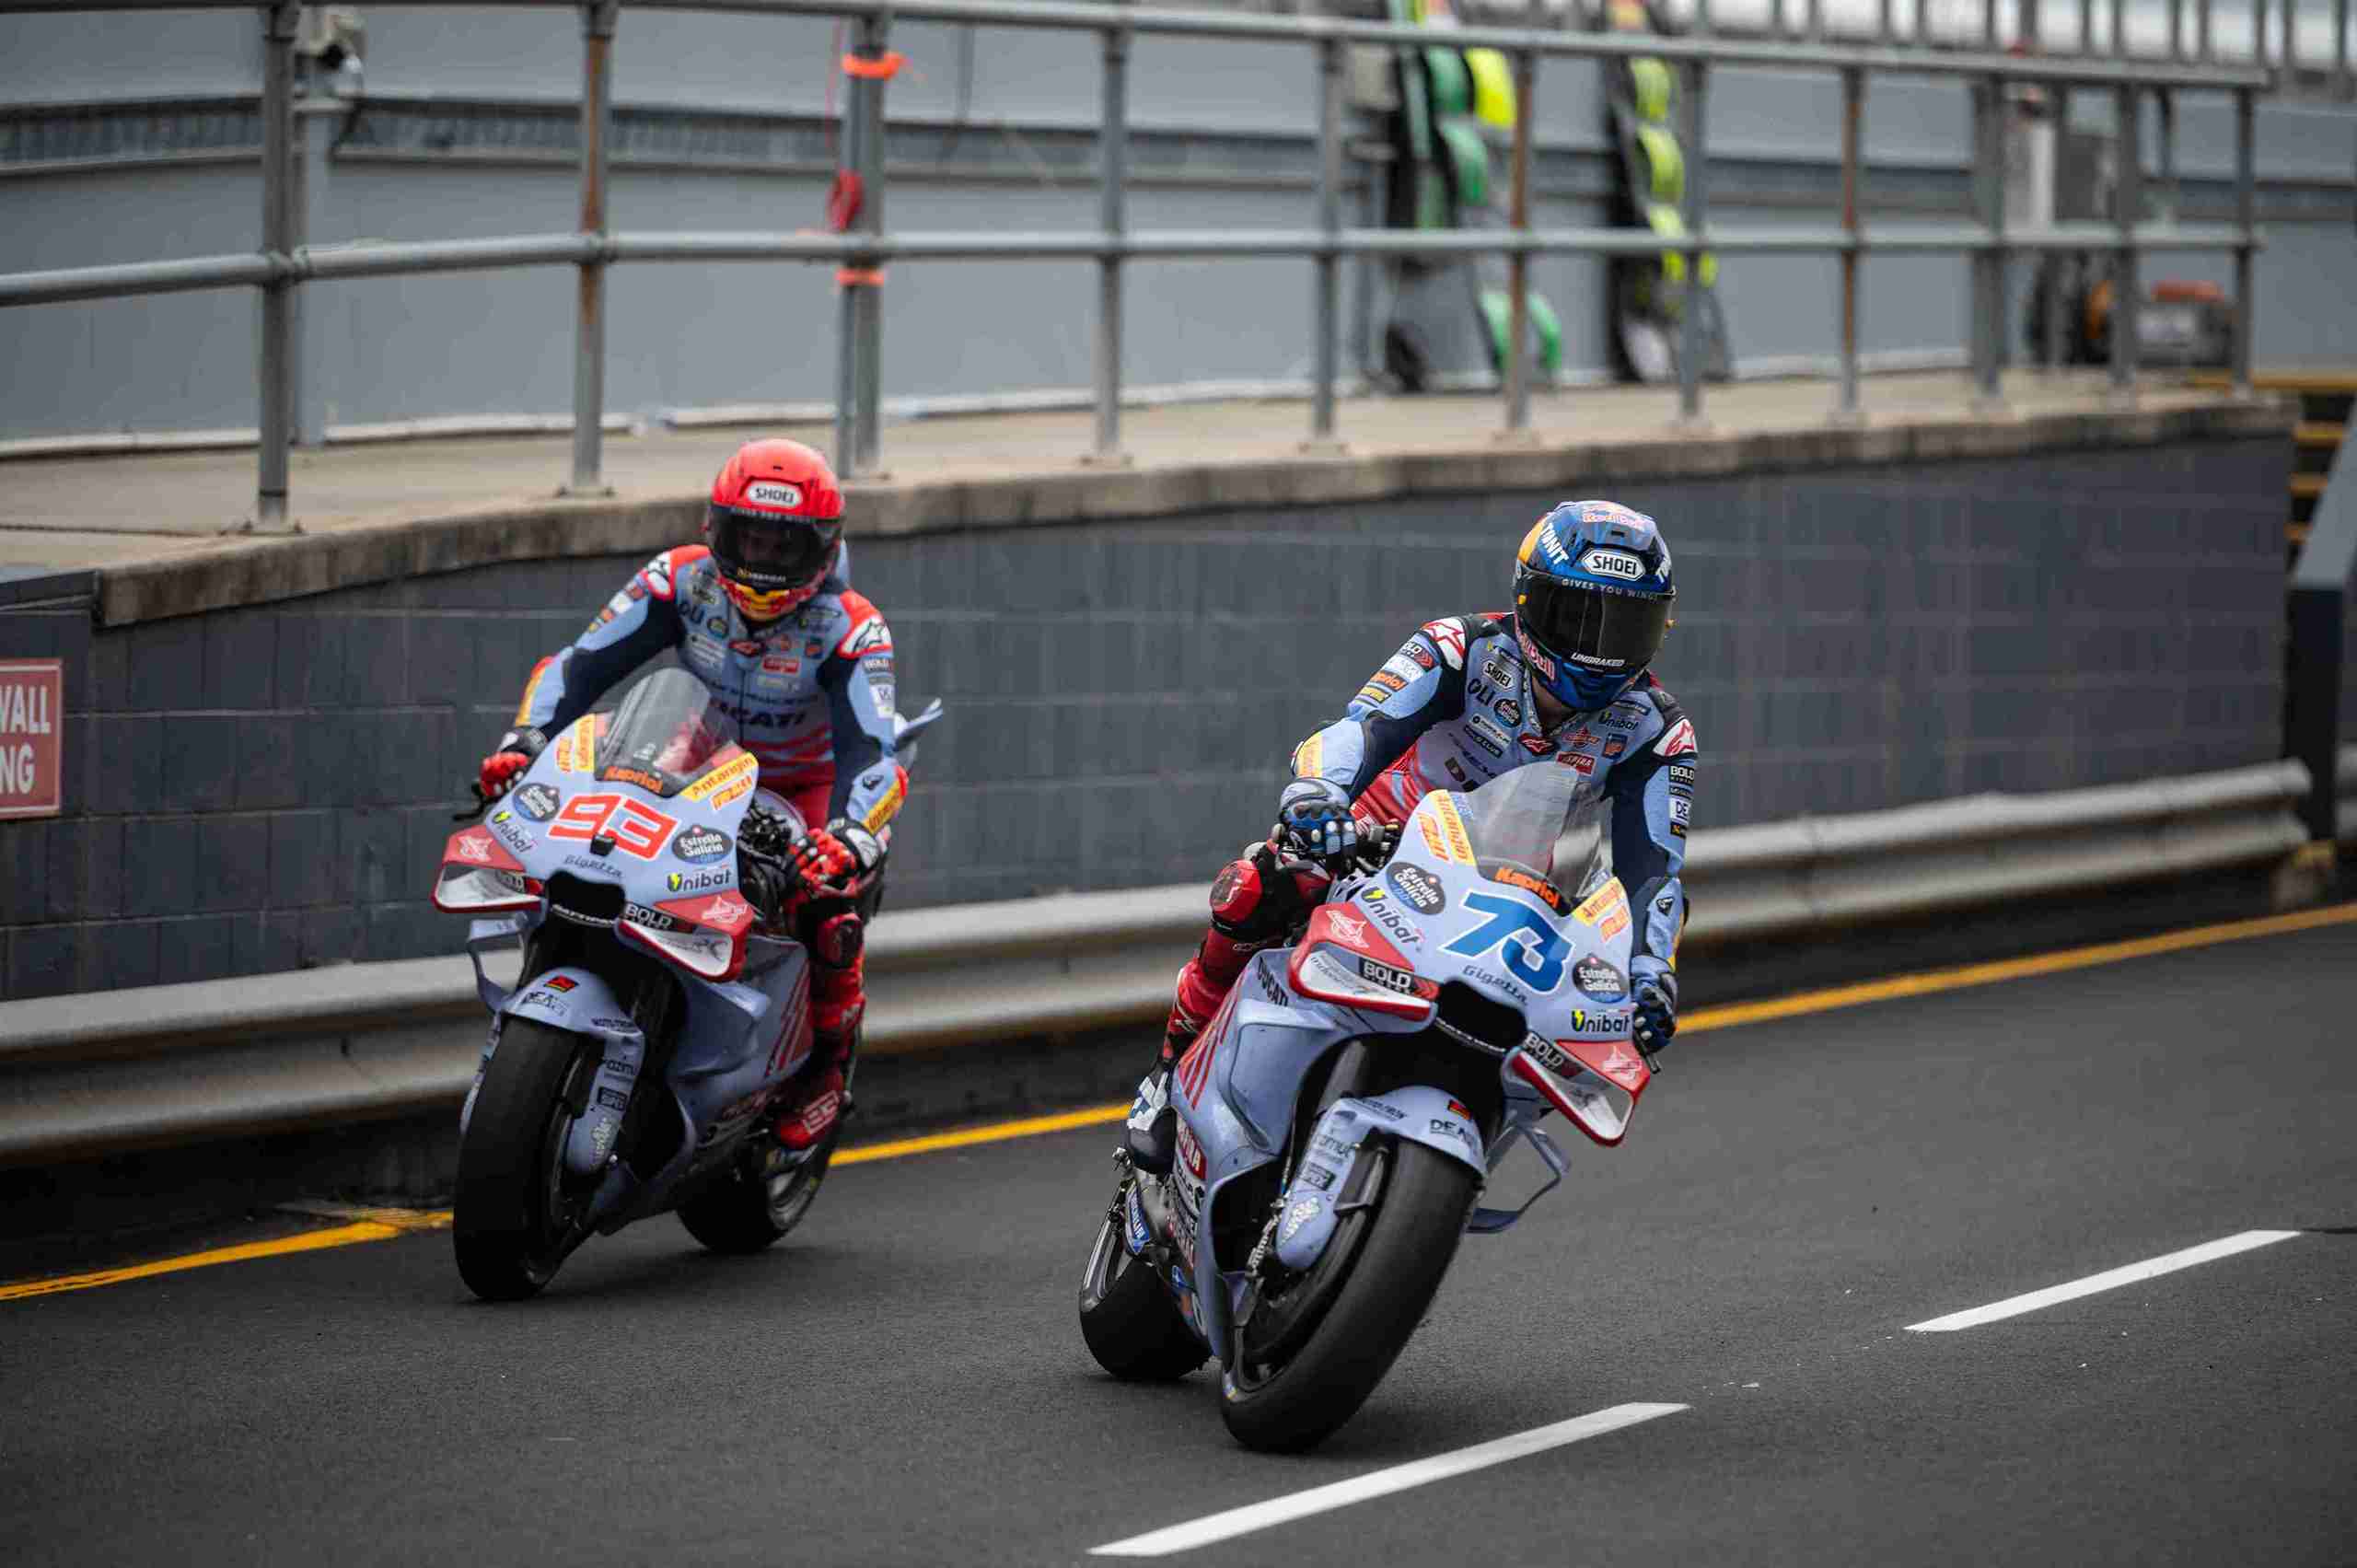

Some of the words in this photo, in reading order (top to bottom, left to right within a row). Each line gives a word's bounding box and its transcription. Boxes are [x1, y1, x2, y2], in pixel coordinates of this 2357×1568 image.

[754, 487, 794, 504] SHOEI
[1593, 554, 1637, 575] SHOEI
[1562, 578, 1593, 589] GIVES
[1600, 585, 1622, 595] YOU
[1484, 662, 1512, 687] SHOEI
[493, 811, 539, 854] Unibat
[547, 792, 680, 862] 93
[679, 834, 723, 849] Estrella
[684, 843, 724, 857] Galicia
[667, 868, 732, 892] Unibat
[1393, 873, 1428, 909] Galicia
[1400, 866, 1440, 905] Estrella
[1495, 868, 1559, 909] Kapriol
[1361, 887, 1421, 945] Unibat
[1437, 889, 1576, 994] 73
[1364, 960, 1411, 989] BOLD
[1572, 1009, 1631, 1032] Unibat
[1525, 1032, 1564, 1066] BOLD
